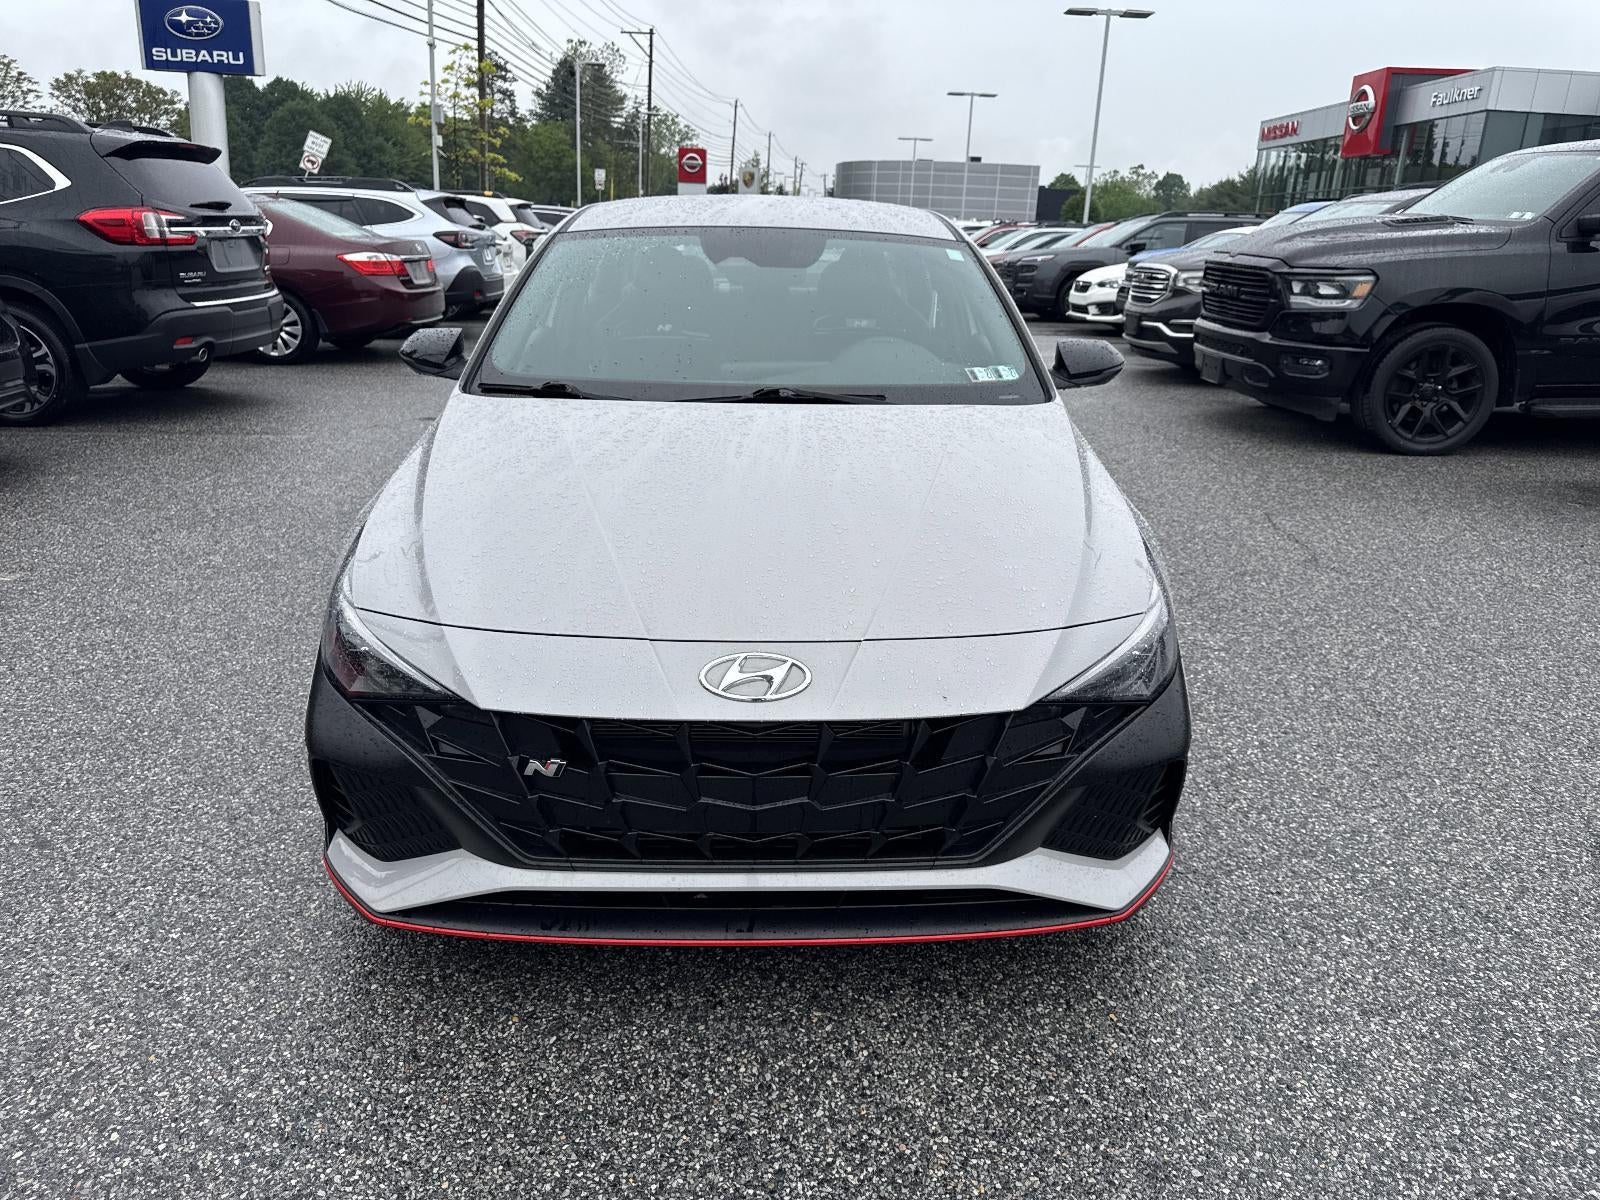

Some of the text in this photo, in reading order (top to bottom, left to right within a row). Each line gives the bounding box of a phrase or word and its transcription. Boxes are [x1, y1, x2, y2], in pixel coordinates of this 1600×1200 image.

[152, 47, 244, 65] SUBARU
[1431, 86, 1481, 107] Faulkner
[1261, 121, 1299, 142] NISSAN
[524, 759, 566, 778] N
